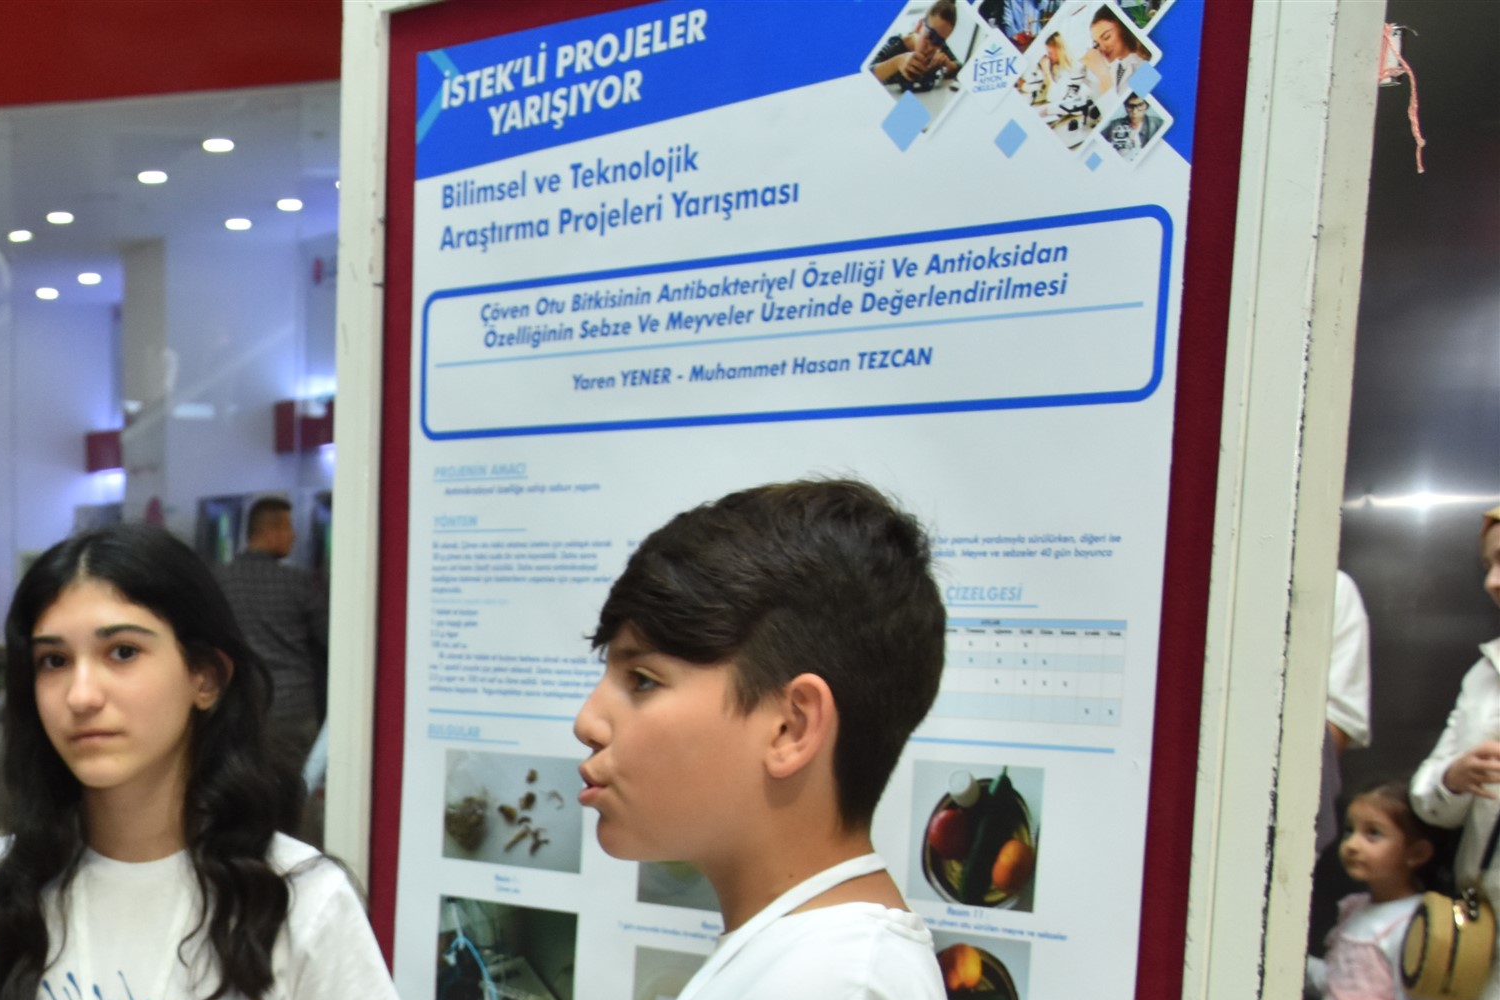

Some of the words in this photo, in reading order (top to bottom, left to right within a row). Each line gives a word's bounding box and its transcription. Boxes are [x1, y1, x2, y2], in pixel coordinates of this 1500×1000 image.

[555, 8, 708, 79] PROJELER
[487, 69, 643, 136] YARIŞIYOR
[441, 170, 527, 210] Bilimsel
[534, 173, 561, 194] ve
[570, 143, 699, 190] Teknolojik
[439, 217, 550, 253] Araştırma
[558, 194, 663, 237] Projeleri
[671, 182, 800, 221] Yarışması
[480, 302, 530, 327] Çöven
[535, 297, 566, 317] Otu
[570, 286, 651, 314] Bitkisinin
[656, 268, 796, 301] Antibakteriyel
[801, 259, 886, 289] Özelliği
[891, 256, 919, 279] Ve
[924, 241, 1069, 276] Antioksidan
[483, 321, 574, 349] Özelliğinin
[579, 318, 632, 341] Sebze
[638, 314, 660, 334] Ve
[665, 304, 755, 334] Meyveler
[760, 294, 854, 323] Üzerinde
[860, 272, 1069, 316] Değerlendirilmesi
[572, 373, 616, 391] Yaren
[620, 367, 672, 387] YENER
[688, 360, 787, 383] Muhammet
[791, 355, 851, 376] Hasan
[857, 346, 934, 370] TEZCAN
[945, 582, 1024, 605] ÇİZELGESİ
